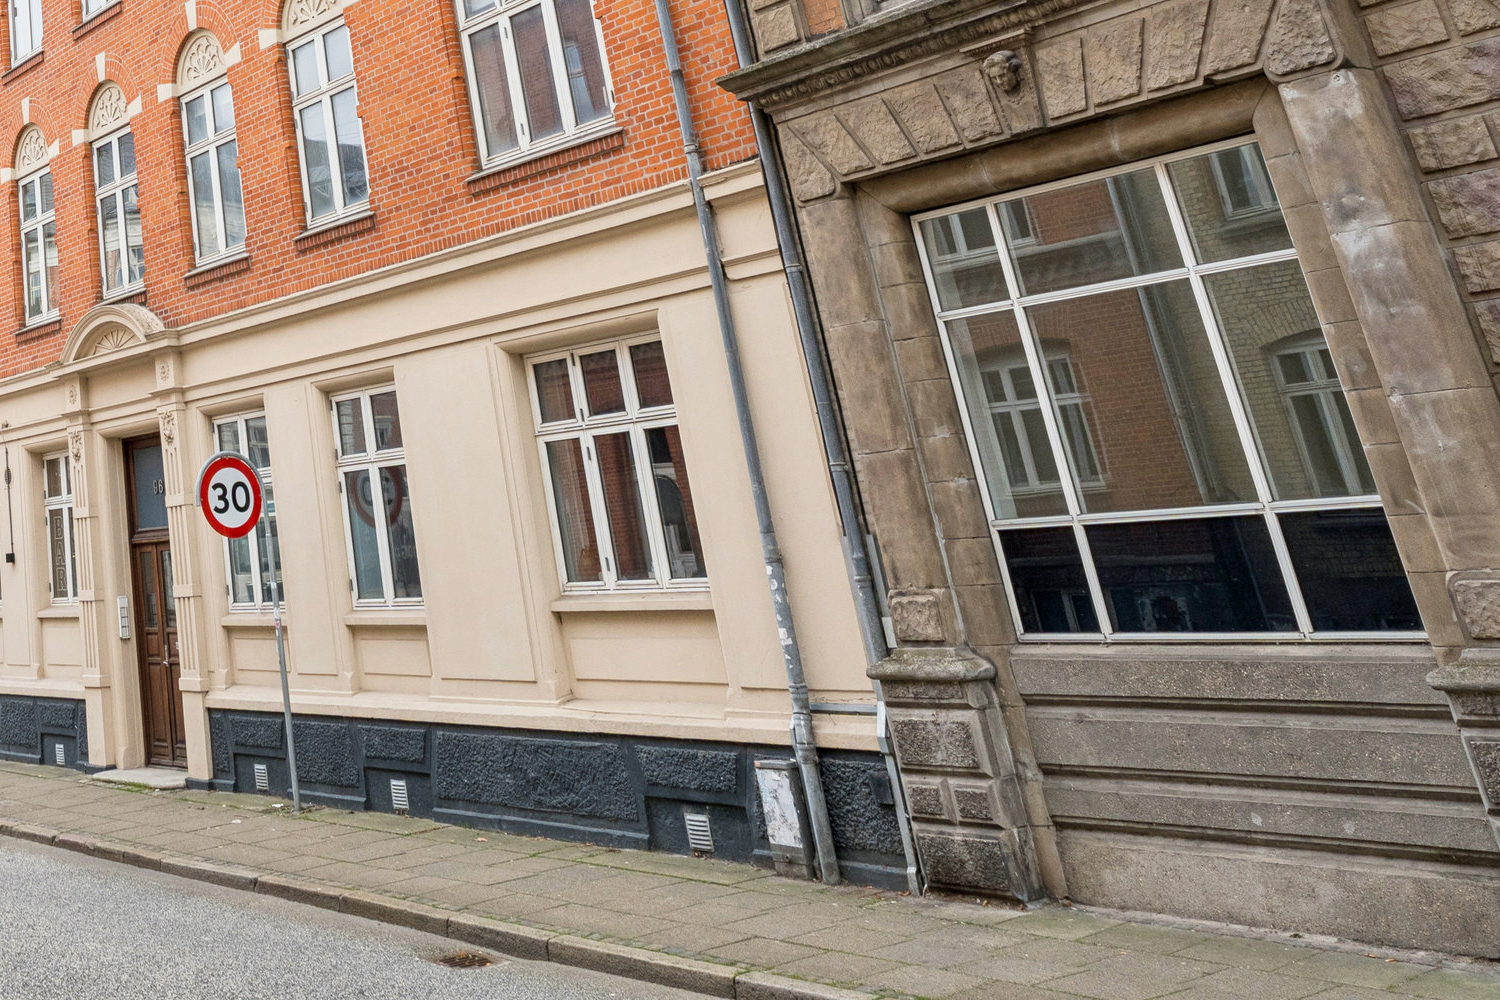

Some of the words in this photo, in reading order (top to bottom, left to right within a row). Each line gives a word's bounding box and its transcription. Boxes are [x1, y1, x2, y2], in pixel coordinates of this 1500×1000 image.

[153, 479, 164, 494] 96
[211, 481, 250, 514] 30
[54, 516, 67, 591] BAR
